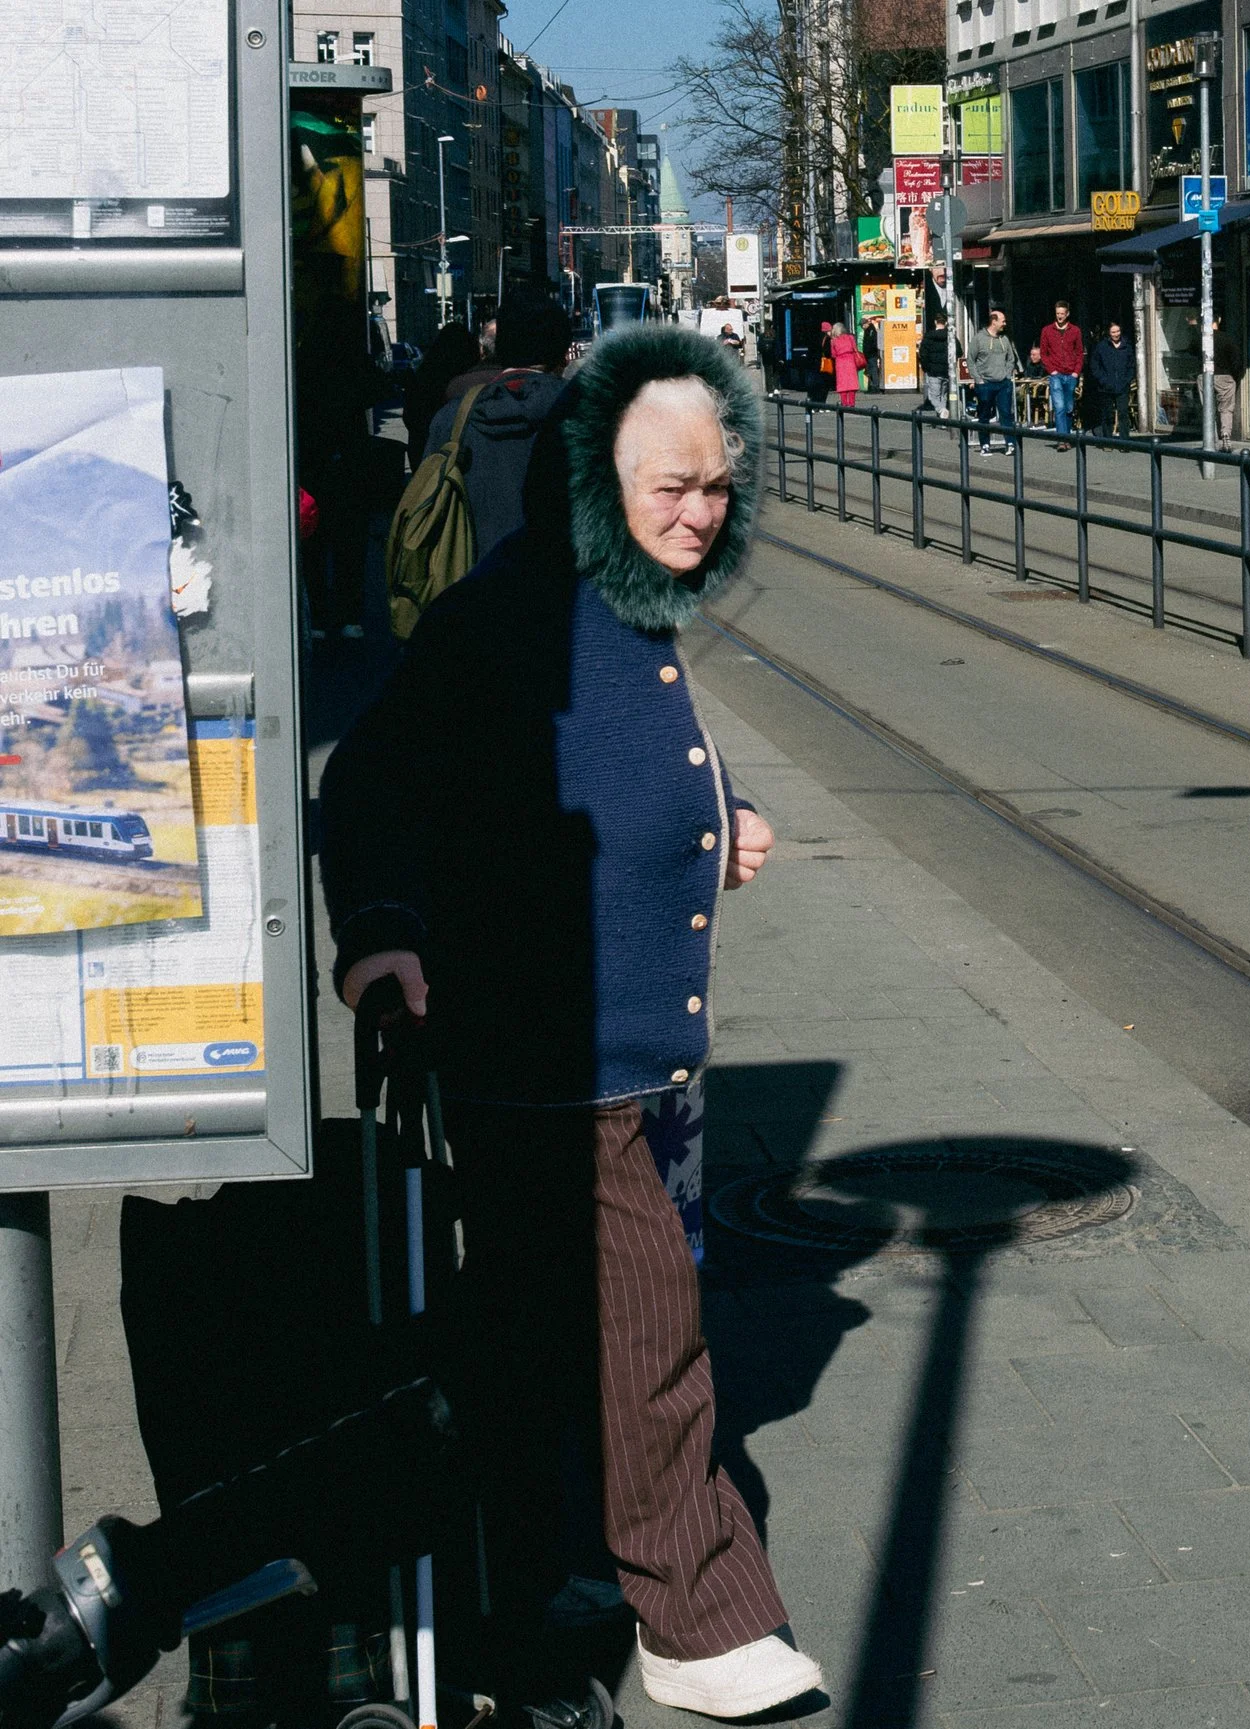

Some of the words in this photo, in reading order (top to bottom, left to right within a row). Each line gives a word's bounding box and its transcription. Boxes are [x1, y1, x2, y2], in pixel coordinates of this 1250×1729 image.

[897, 101, 938, 113] radius
[1093, 191, 1140, 216] GOLD
[0, 567, 120, 600] stenlos
[0, 612, 78, 639] hren
[56, 664, 78, 679] Du
[83, 662, 106, 677] für
[64, 685, 97, 699] kein
